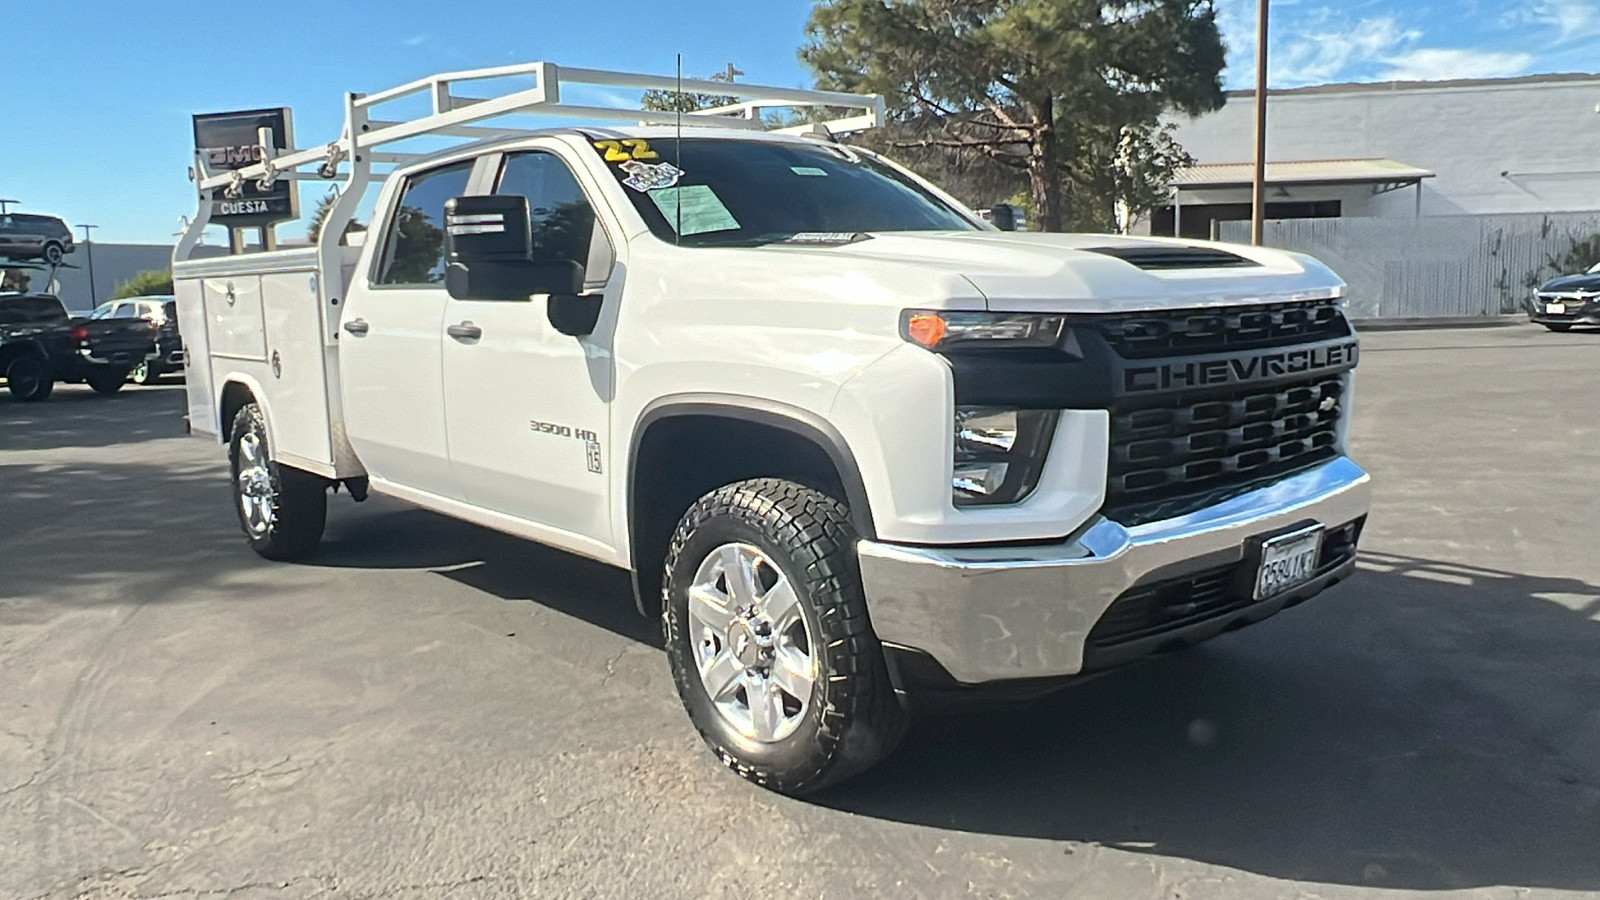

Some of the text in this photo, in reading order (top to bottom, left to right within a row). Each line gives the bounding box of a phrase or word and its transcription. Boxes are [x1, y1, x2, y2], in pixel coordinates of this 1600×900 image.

[594, 139, 658, 161] 22
[221, 201, 268, 214] CUESTA
[1124, 343, 1356, 392] CHEVROLET
[530, 420, 597, 442] 3500 HD
[588, 451, 600, 471] 15
